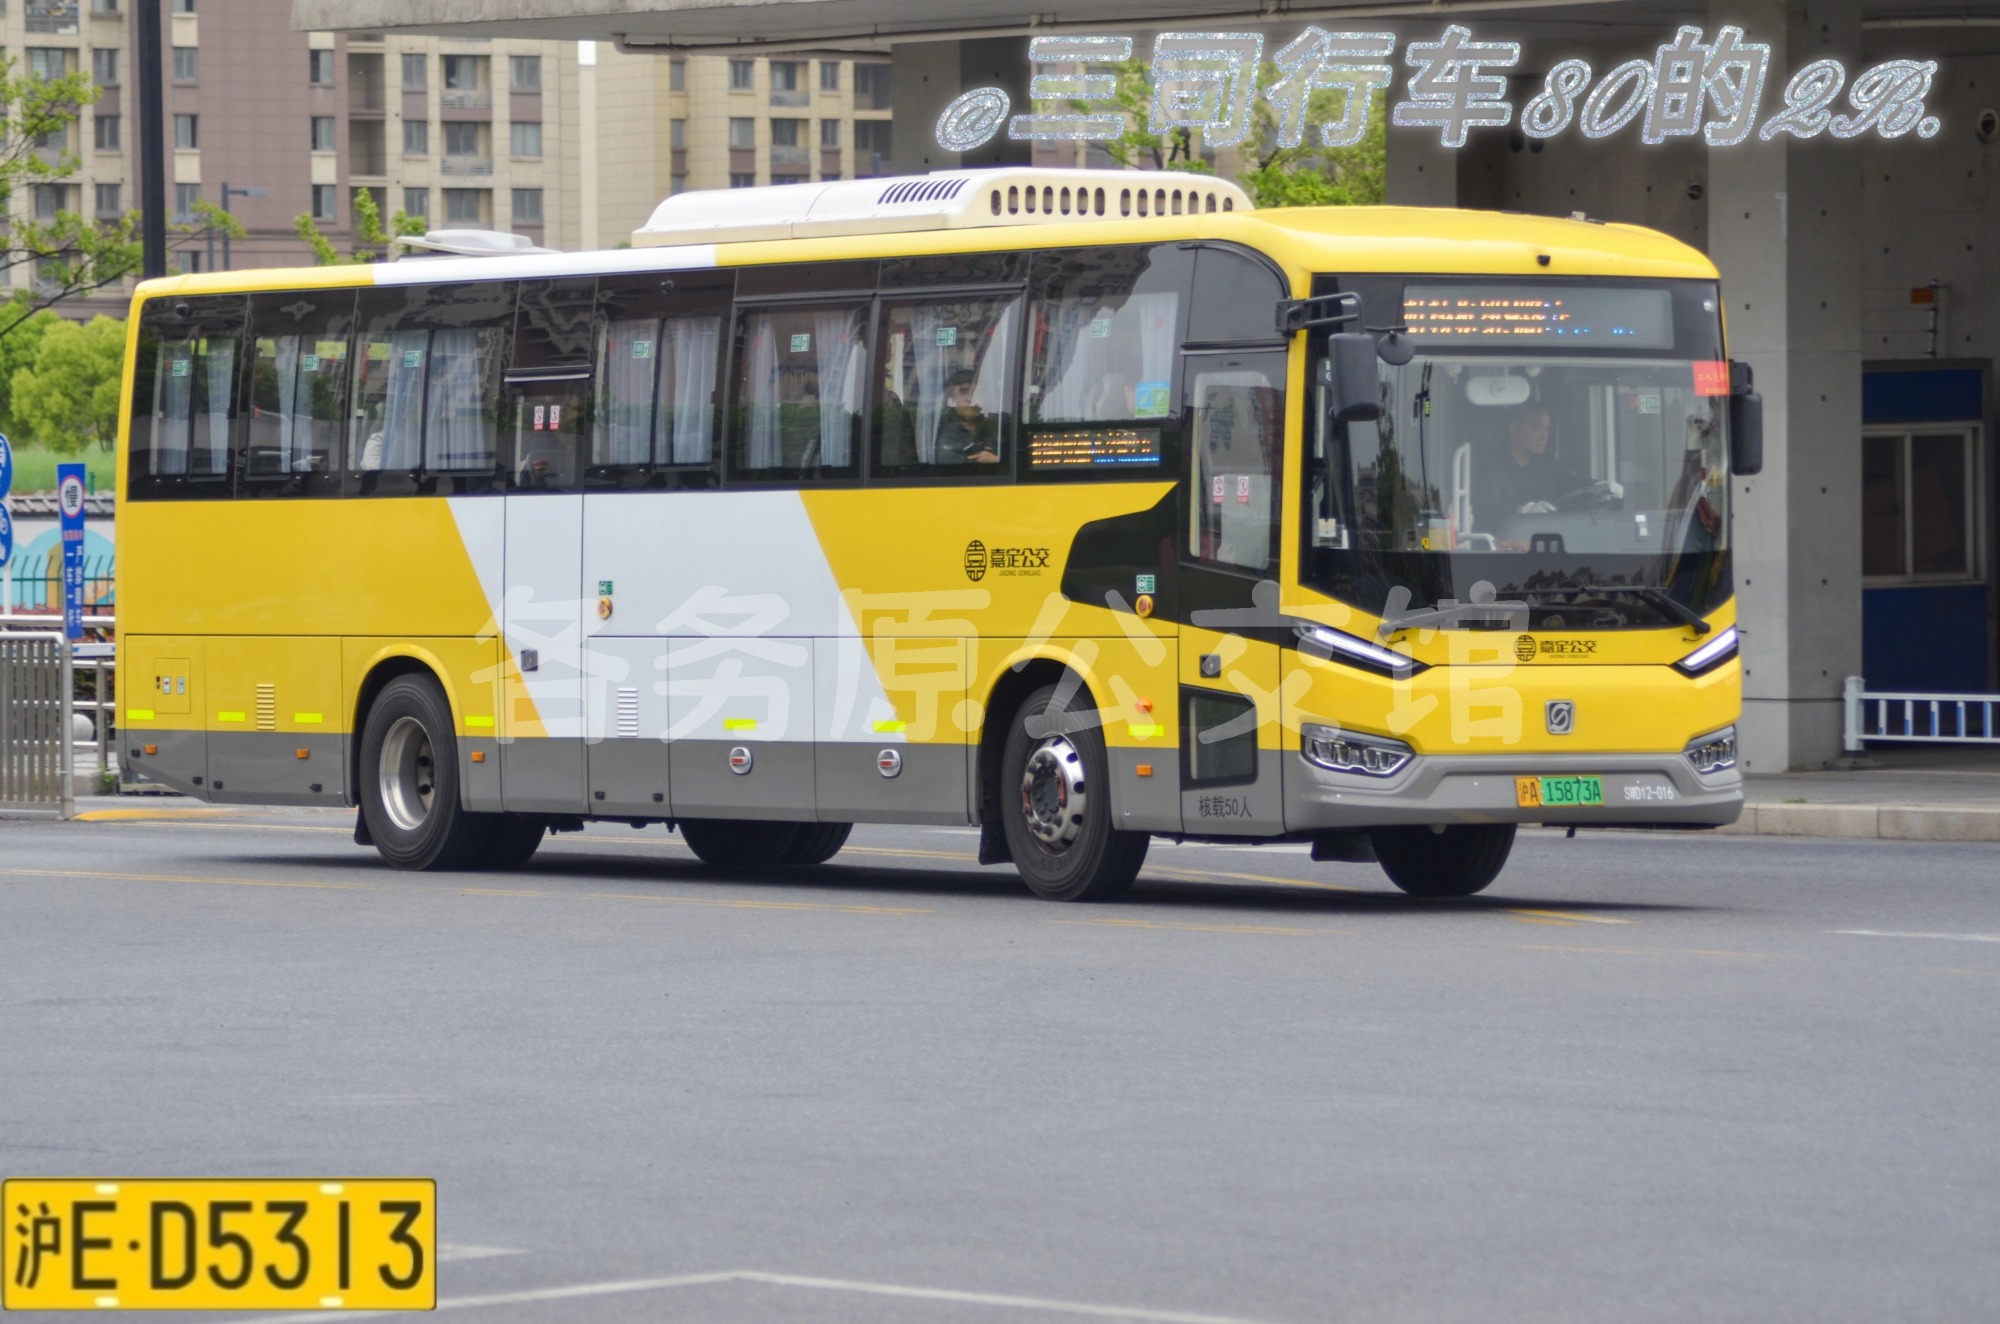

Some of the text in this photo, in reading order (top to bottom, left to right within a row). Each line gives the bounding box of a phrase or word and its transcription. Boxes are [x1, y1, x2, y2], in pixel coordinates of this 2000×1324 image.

[990, 547, 1050, 568] 嘉定公交
[1539, 640, 1598, 654] 嘉定公交
[1198, 795, 1252, 818] 核载50人
